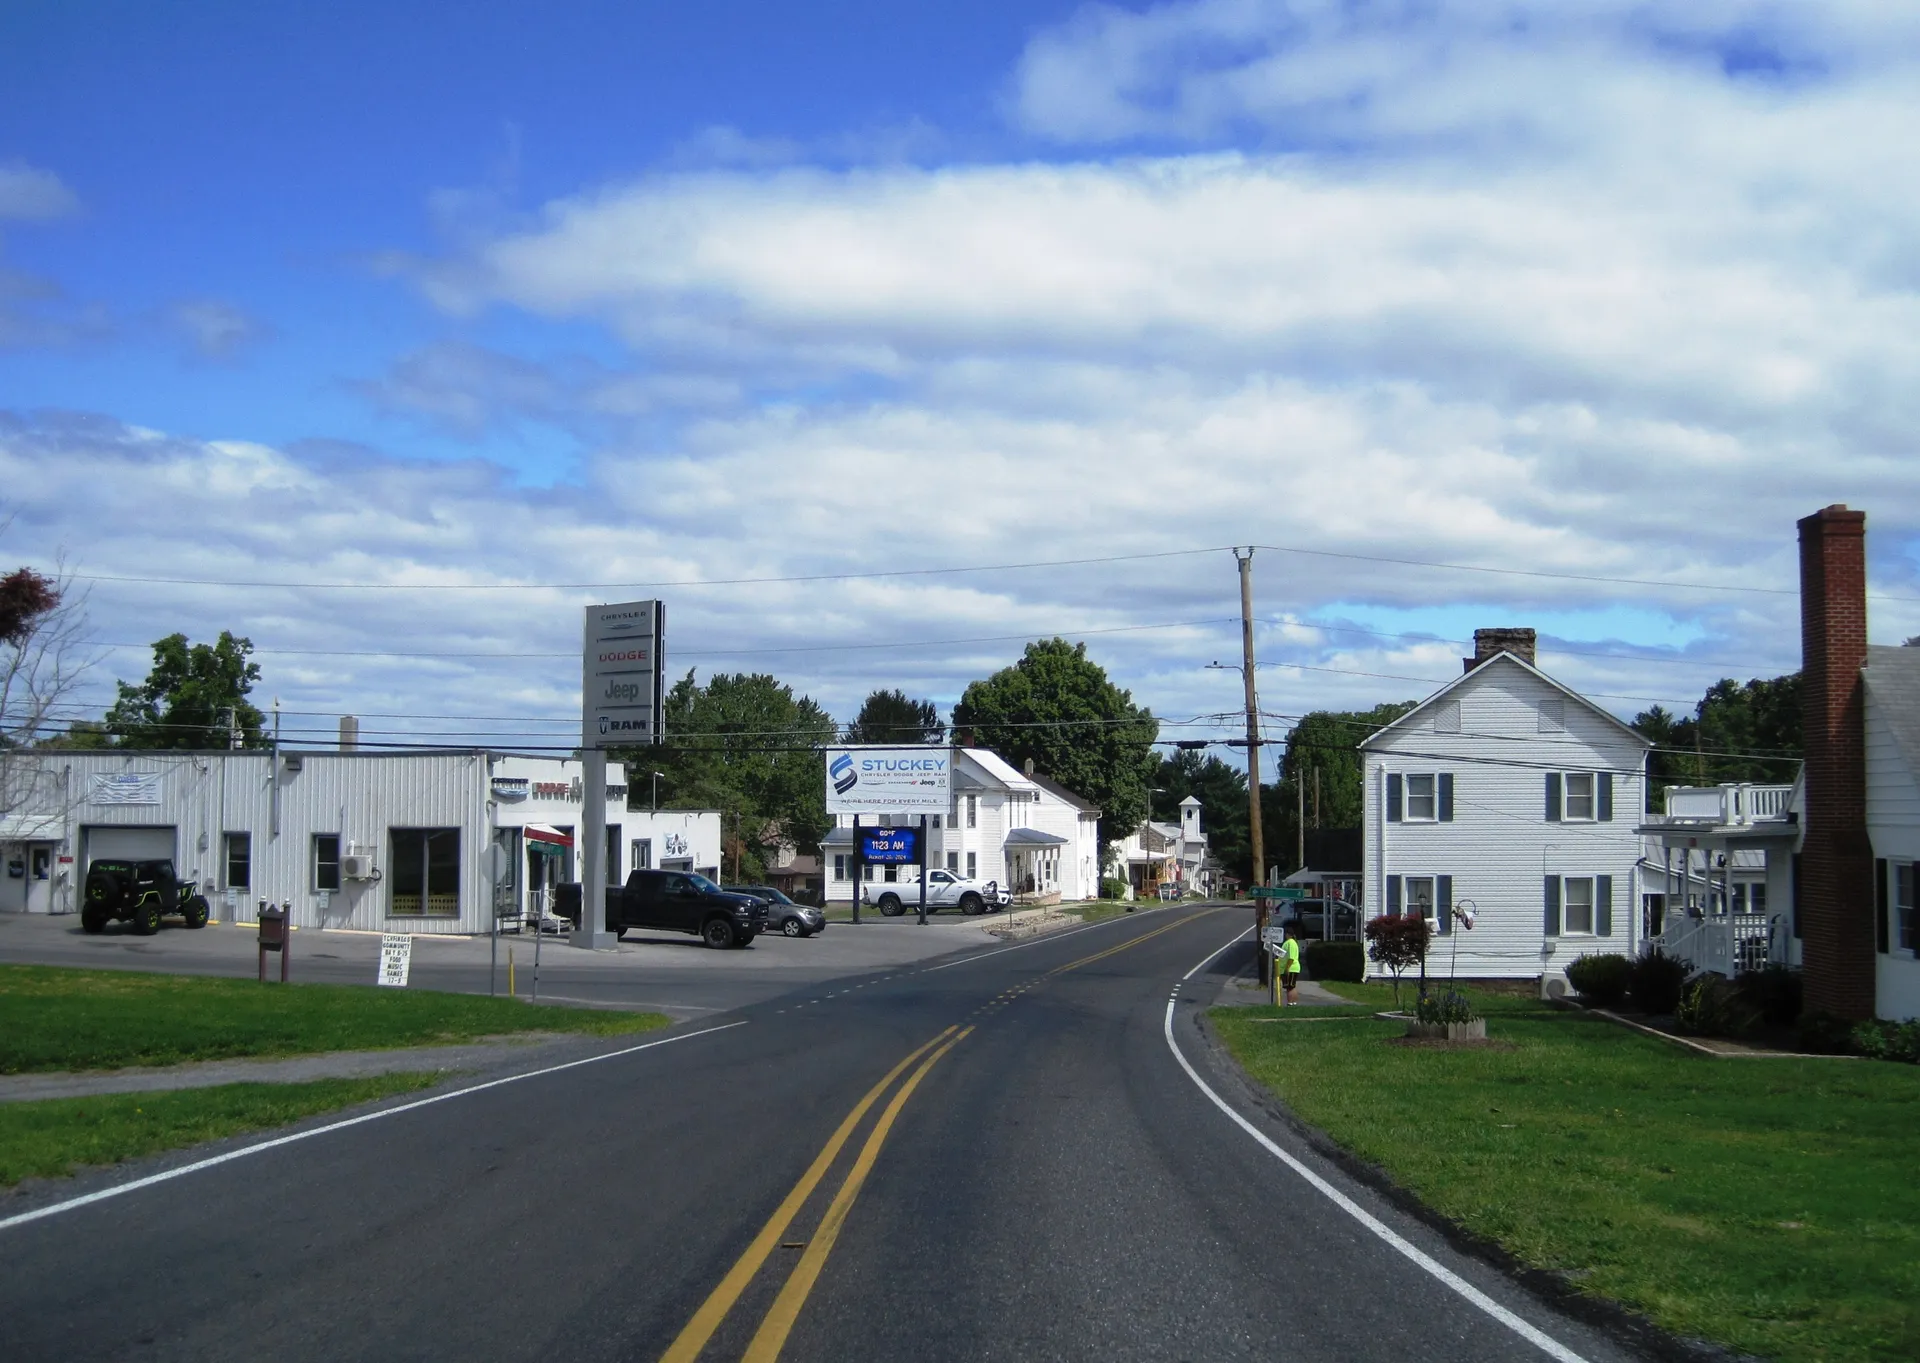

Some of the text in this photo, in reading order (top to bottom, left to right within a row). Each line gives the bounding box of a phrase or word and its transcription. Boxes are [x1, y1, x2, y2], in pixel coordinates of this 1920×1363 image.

[601, 611, 646, 621] CHRYSLER
[599, 650, 647, 662] DODGE
[605, 680, 639, 702] Jeep
[611, 720, 647, 730] RAM
[862, 759, 946, 771] STUCKEY
[920, 779, 935, 787] Jeep
[892, 840, 905, 850] AM
